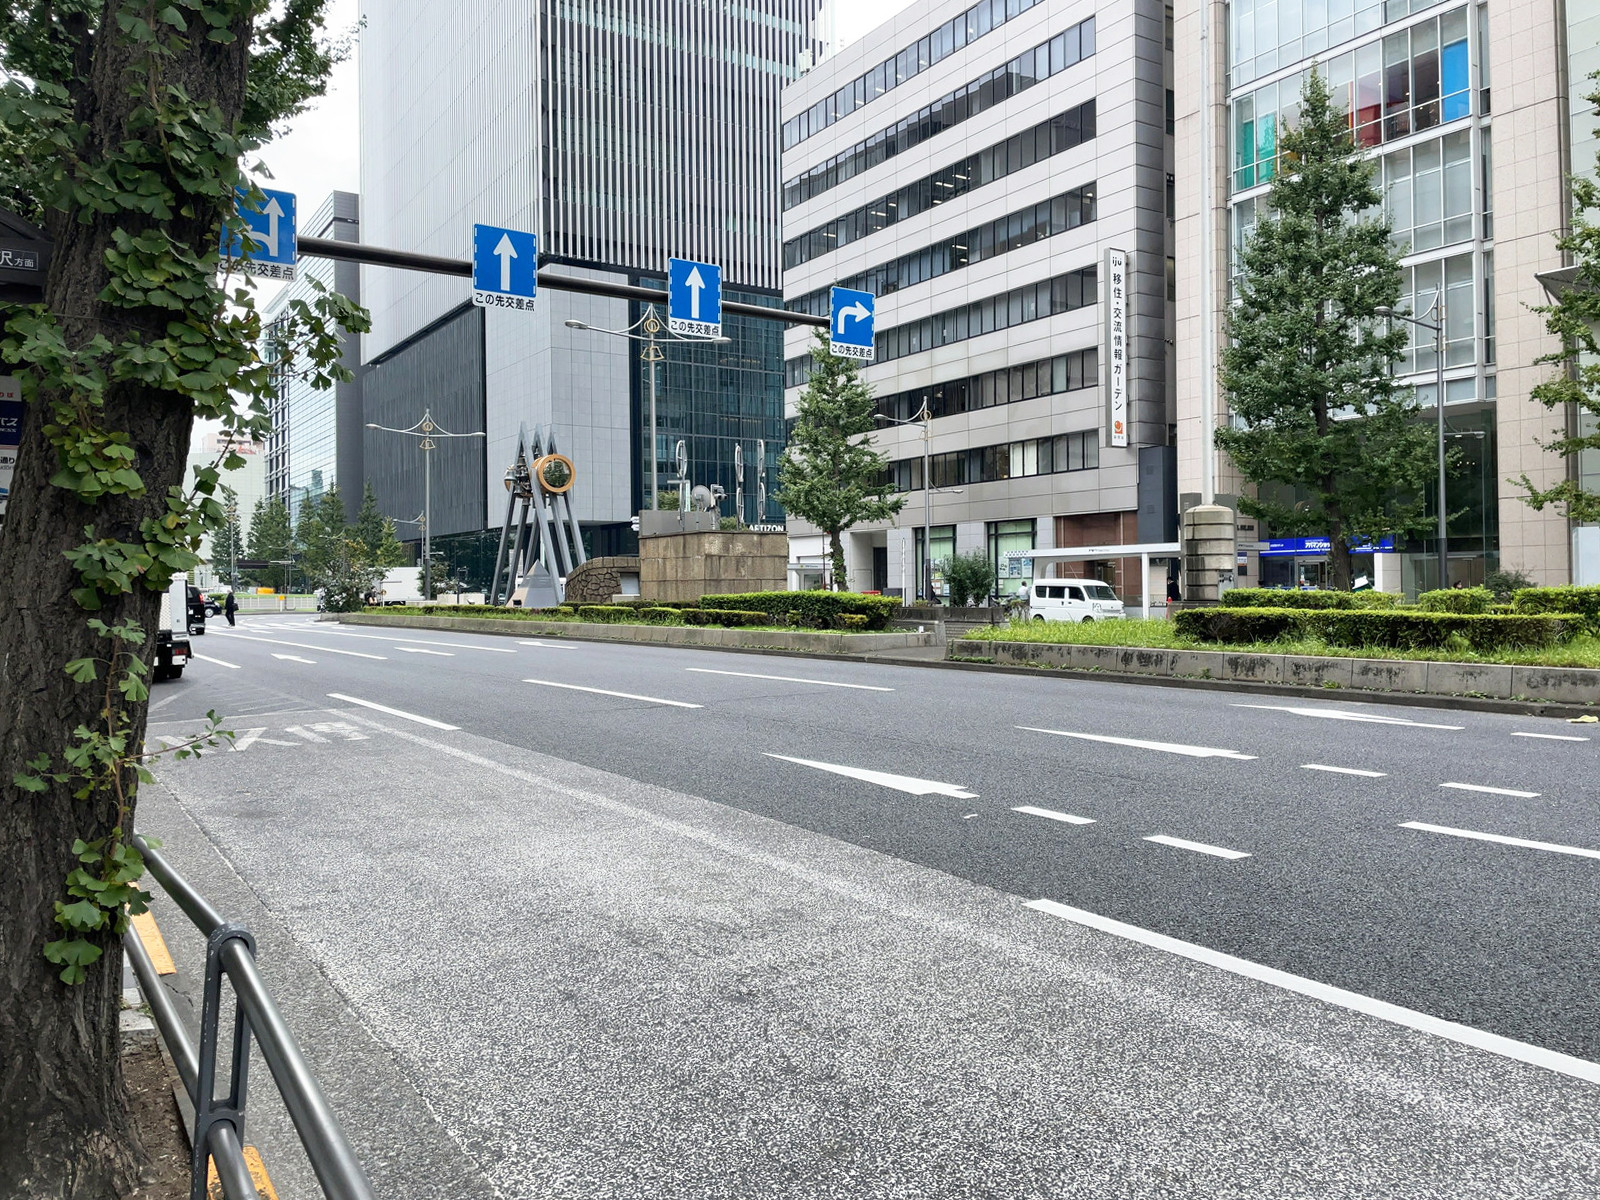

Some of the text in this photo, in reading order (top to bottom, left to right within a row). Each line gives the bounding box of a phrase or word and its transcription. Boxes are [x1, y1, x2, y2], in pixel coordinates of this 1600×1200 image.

[475, 292, 535, 312] この先交差点
[671, 320, 720, 337] この先交差点
[831, 343, 874, 359] この先交差点
[1113, 273, 1123, 411] 移住・交流情報ガーデン
